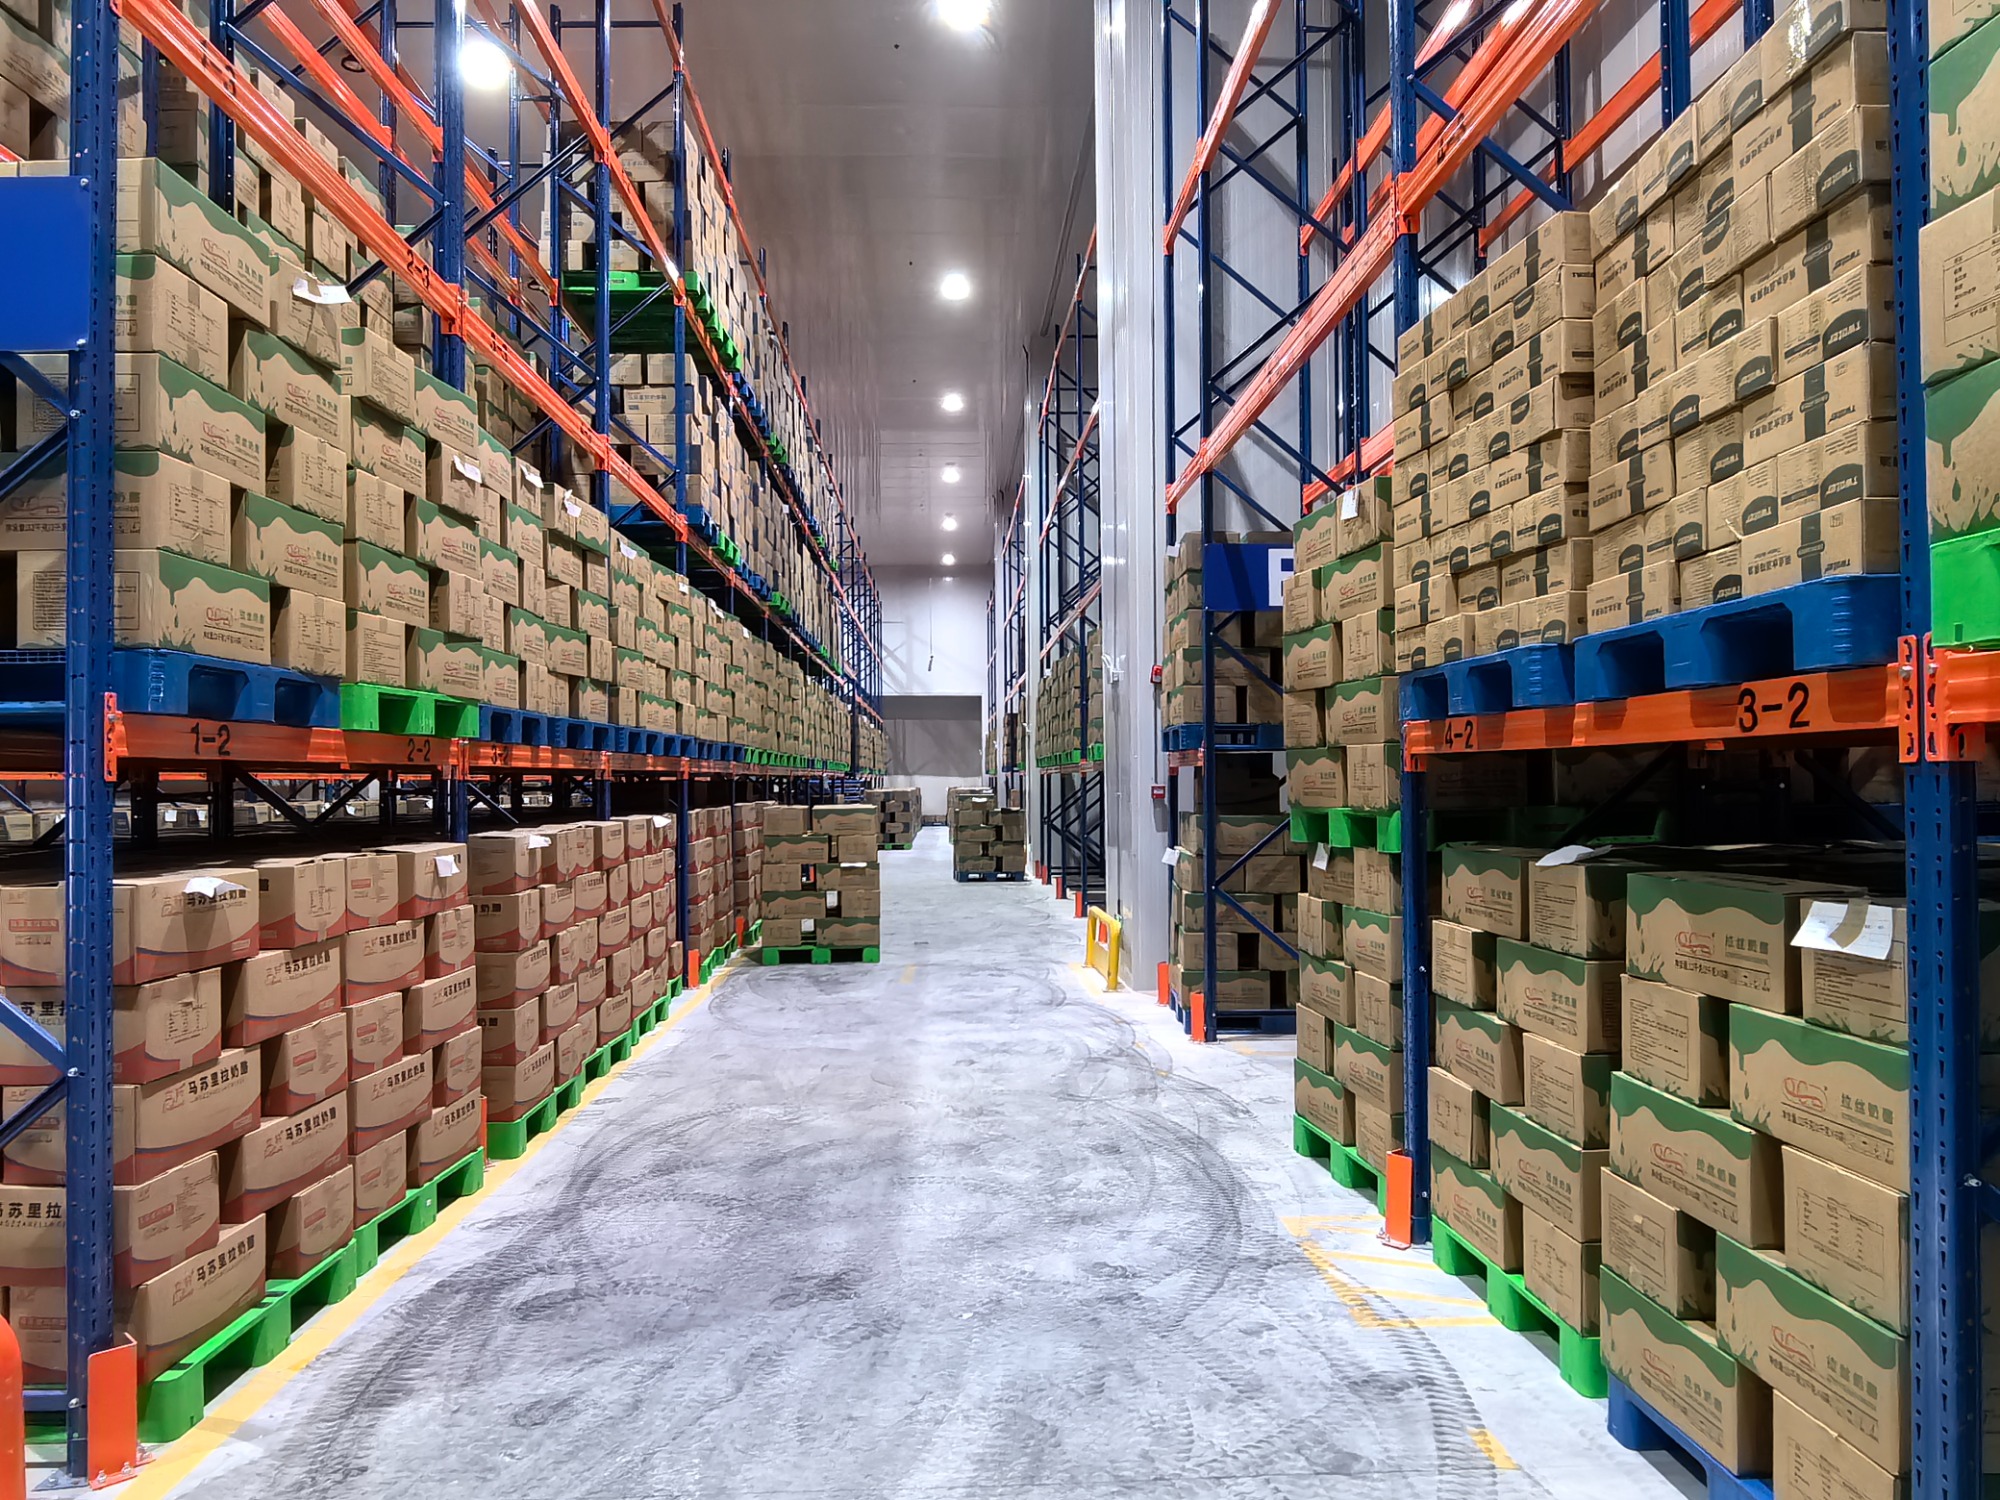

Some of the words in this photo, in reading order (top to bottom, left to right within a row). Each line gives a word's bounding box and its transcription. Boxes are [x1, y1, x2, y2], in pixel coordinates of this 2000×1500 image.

[406, 249, 430, 290] 2-3
[1738, 681, 1810, 733] 3-2
[194, 724, 231, 757] 1-2
[407, 739, 431, 762] 2-2
[1445, 720, 1474, 750] 4-2
[188, 1060, 249, 1095] 马苏里拉奶酪
[285, 1106, 337, 1140] 马苏里拉奶酪
[196, 1234, 256, 1282] 马苏里拉奶酪
